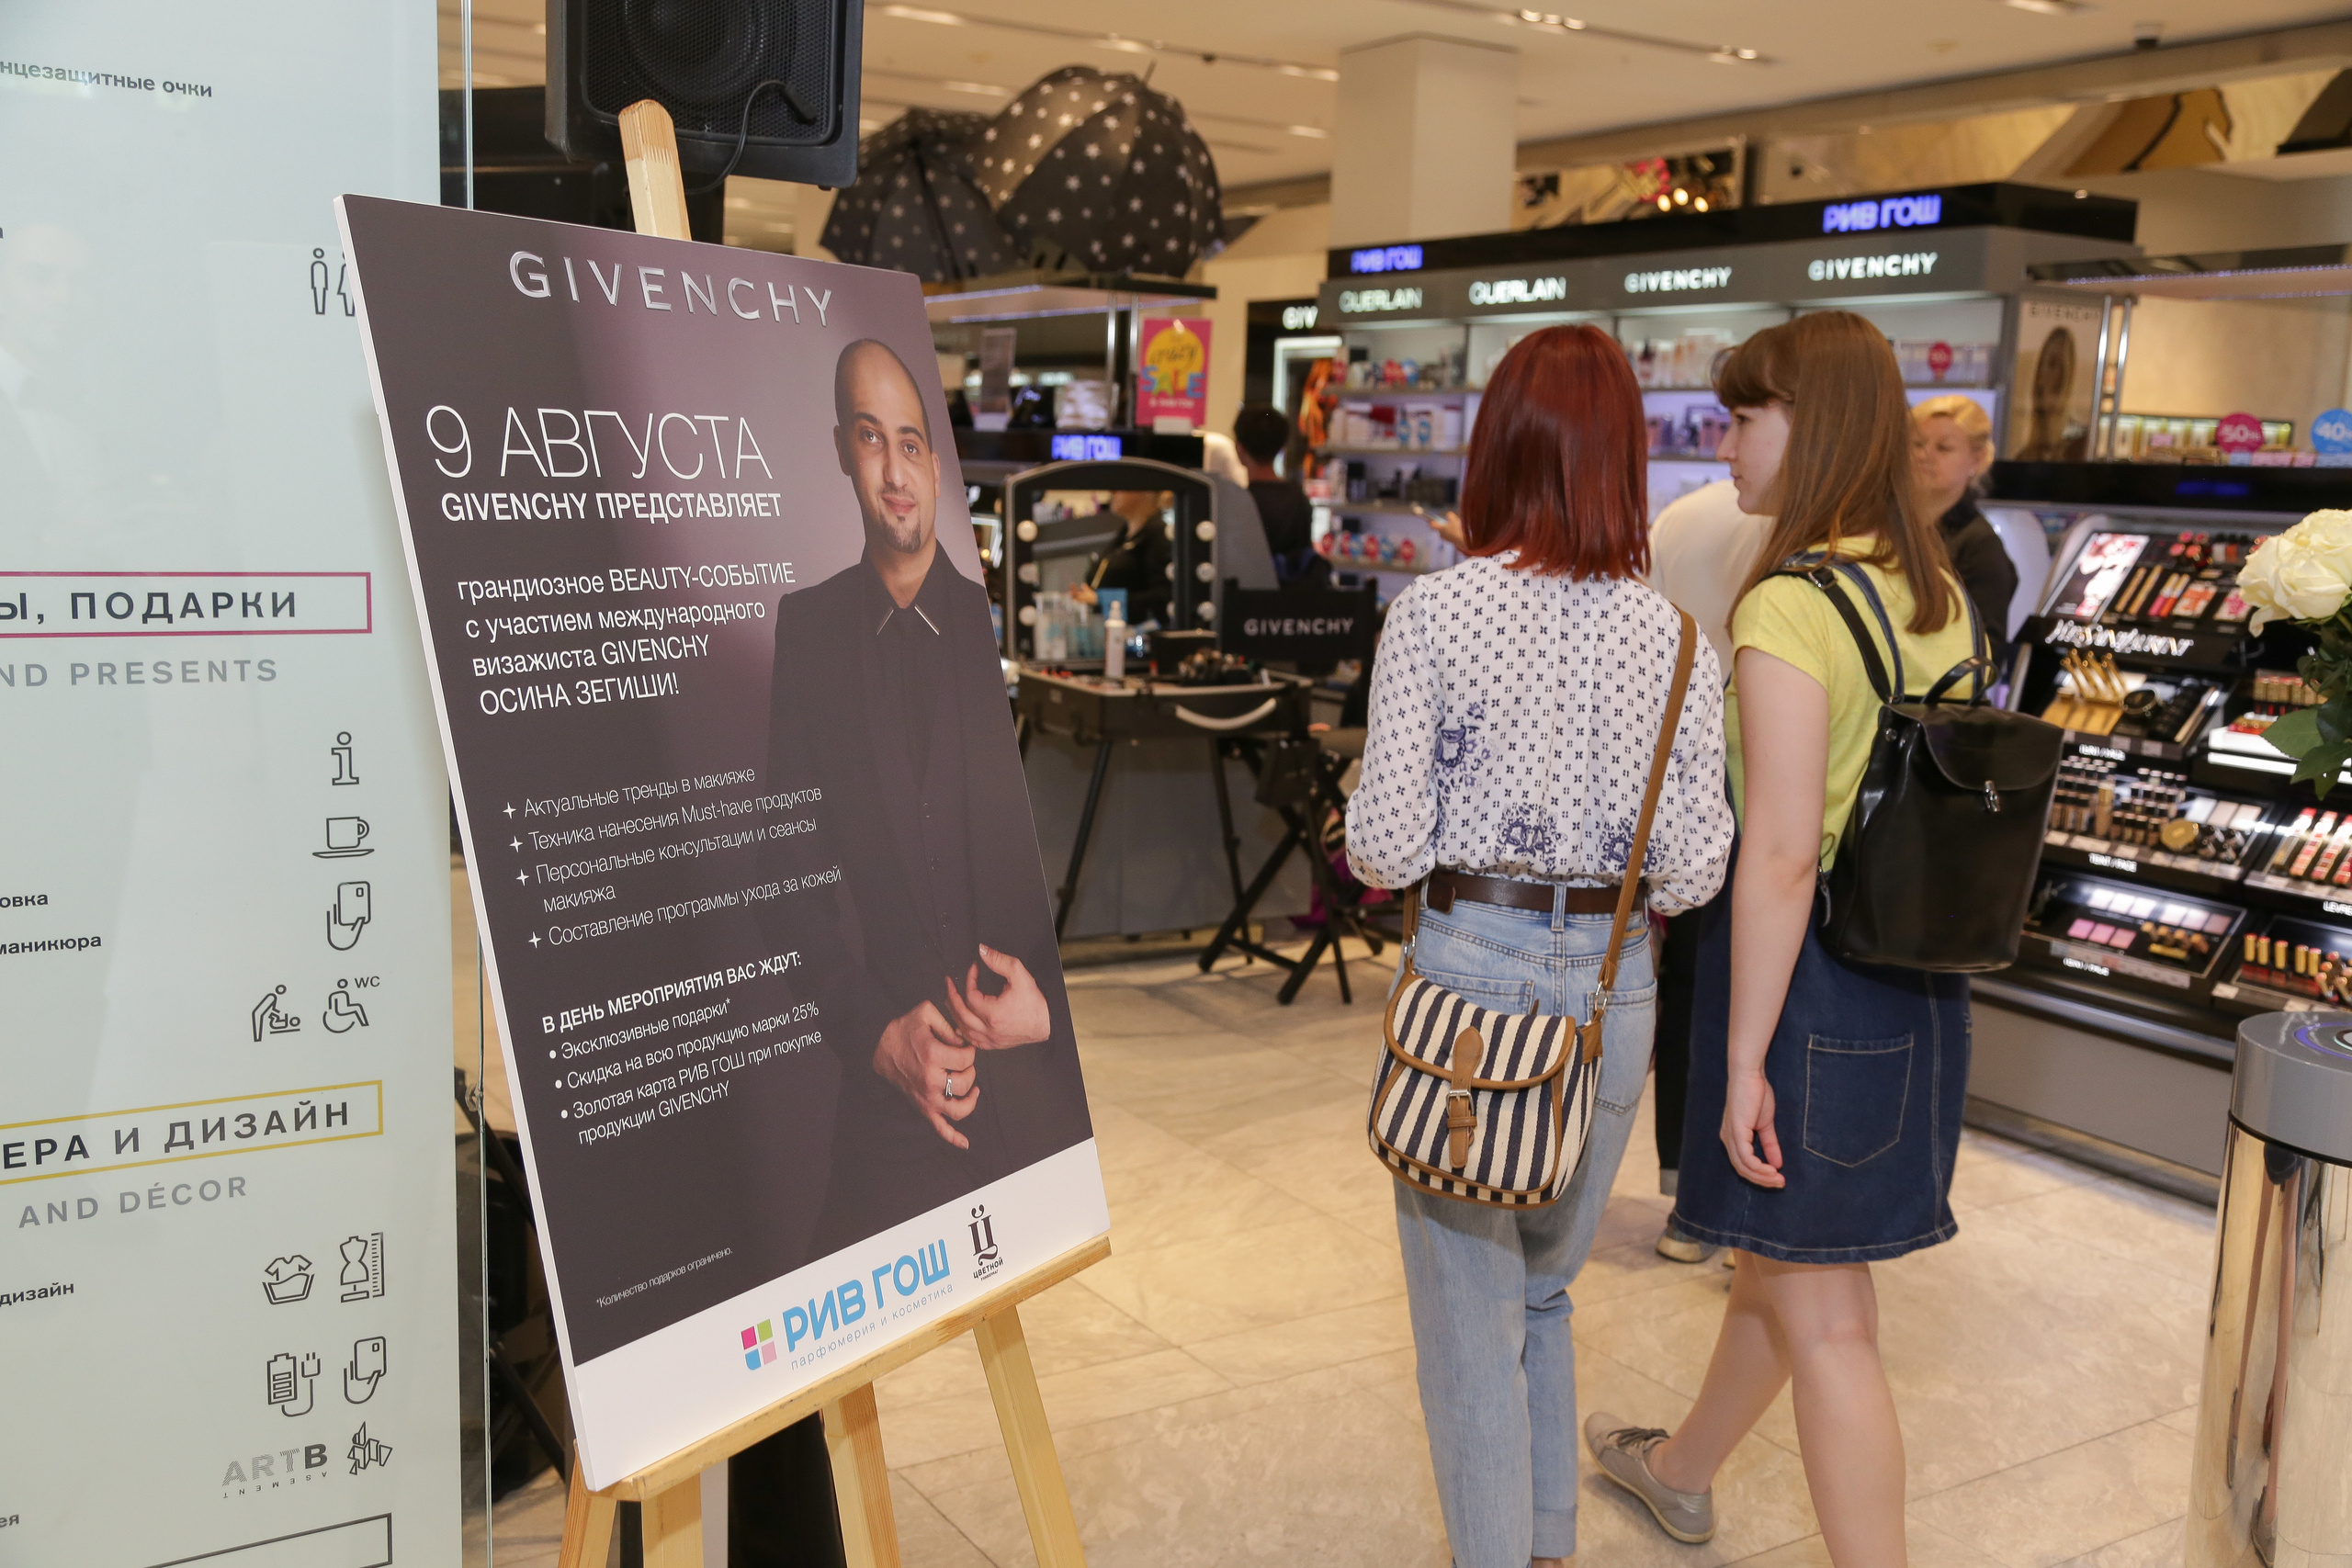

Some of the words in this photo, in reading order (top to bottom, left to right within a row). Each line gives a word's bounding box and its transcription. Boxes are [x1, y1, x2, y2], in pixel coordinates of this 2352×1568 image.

[162, 80, 212, 97] очки
[1823, 204, 1879, 233] РИВ
[1881, 195, 1942, 227] ГОШ
[1623, 266, 1733, 294] GIVENCHY
[1807, 252, 1938, 281] GIVENCHY
[509, 251, 832, 327] GIVENCHY
[1339, 288, 1423, 312] GUERLAIN
[1468, 276, 1566, 305] GUERLAIN
[1283, 306, 1318, 331] GIV
[1141, 365, 1205, 399] SALE
[426, 405, 471, 478] 9
[501, 407, 773, 479] АВГУСТА
[441, 492, 587, 522] GIVENCHY
[596, 492, 782, 525] ПРЕДСТАВЛЯЕТ
[458, 576, 604, 605] грандиозное
[609, 563, 795, 592] BEAUTY-СОБЫТИЕ
[71, 592, 296, 624] ПОДАРКИ
[466, 620, 480, 637] с
[485, 613, 593, 643] участием
[598, 603, 764, 630] международного
[1243, 617, 1354, 637] GIVENCHY
[71, 659, 277, 686] PRESENTS
[473, 649, 596, 676] визажиста
[602, 635, 708, 664] GIVENCHY
[481, 683, 571, 715] ОСИНА
[576, 672, 679, 704] ЗЕГИШИ!
[526, 790, 618, 817] Актуальные
[622, 781, 678, 804] тренды
[682, 779, 690, 792] в
[695, 769, 754, 789] макияже
[528, 828, 594, 850] Техника
[599, 813, 679, 838] нанесения
[682, 800, 752, 823] Must-have
[756, 788, 821, 813] продуктов
[537, 850, 654, 884] Персональные
[659, 830, 753, 860] консультации
[757, 829, 765, 840] и
[769, 818, 816, 838] сеансы
[544, 886, 616, 912] макияжа
[549, 911, 653, 944] Составление
[658, 892, 739, 923] программы
[741, 883, 780, 906] ухода
[784, 879, 798, 892] за
[801, 865, 841, 888] кожей
[354, 976, 380, 988] WC
[542, 1016, 555, 1033] В
[560, 1004, 605, 1029] ДЕНЬ
[608, 972, 723, 1016] МЕРОПРИЯТИЯ
[727, 964, 755, 984] ВАС
[759, 952, 801, 976] ЖДУТ:
[561, 1020, 669, 1058] Эксклюзивные
[568, 1063, 622, 1088] Скидка
[626, 1057, 643, 1072] на
[646, 1048, 673, 1066] всю
[677, 1025, 749, 1057] продукцию
[752, 1013, 789, 1033] марки
[793, 1001, 819, 1021] 25%
[573, 1089, 633, 1118] Золотая
[637, 1077, 676, 1099] карта
[679, 1064, 708, 1085] РИВ
[712, 1052, 744, 1075] ГОШ
[749, 1047, 771, 1065] при
[775, 1032, 821, 1055] покупке
[579, 1109, 655, 1145] продукции
[659, 1080, 729, 1116] GIVENCHY
[4, 1134, 89, 1169] ЕРА
[115, 1128, 139, 1154] И
[164, 1100, 348, 1153] ДИЗАЙН
[19, 1198, 98, 1228] AND
[120, 1177, 245, 1213] DÉCOR
[649, 1266, 686, 1288] подарков
[687, 1247, 733, 1271] ограничено.
[973, 1257, 1004, 1280] ЦВЕТНОЙ
[0, 1281, 74, 1307] дизайн
[783, 1280, 865, 1352] РИВ
[872, 1240, 952, 1309] ГОШ
[791, 1323, 876, 1371] парфюмерия
[880, 1315, 888, 1326] и
[893, 1283, 954, 1321] косметика
